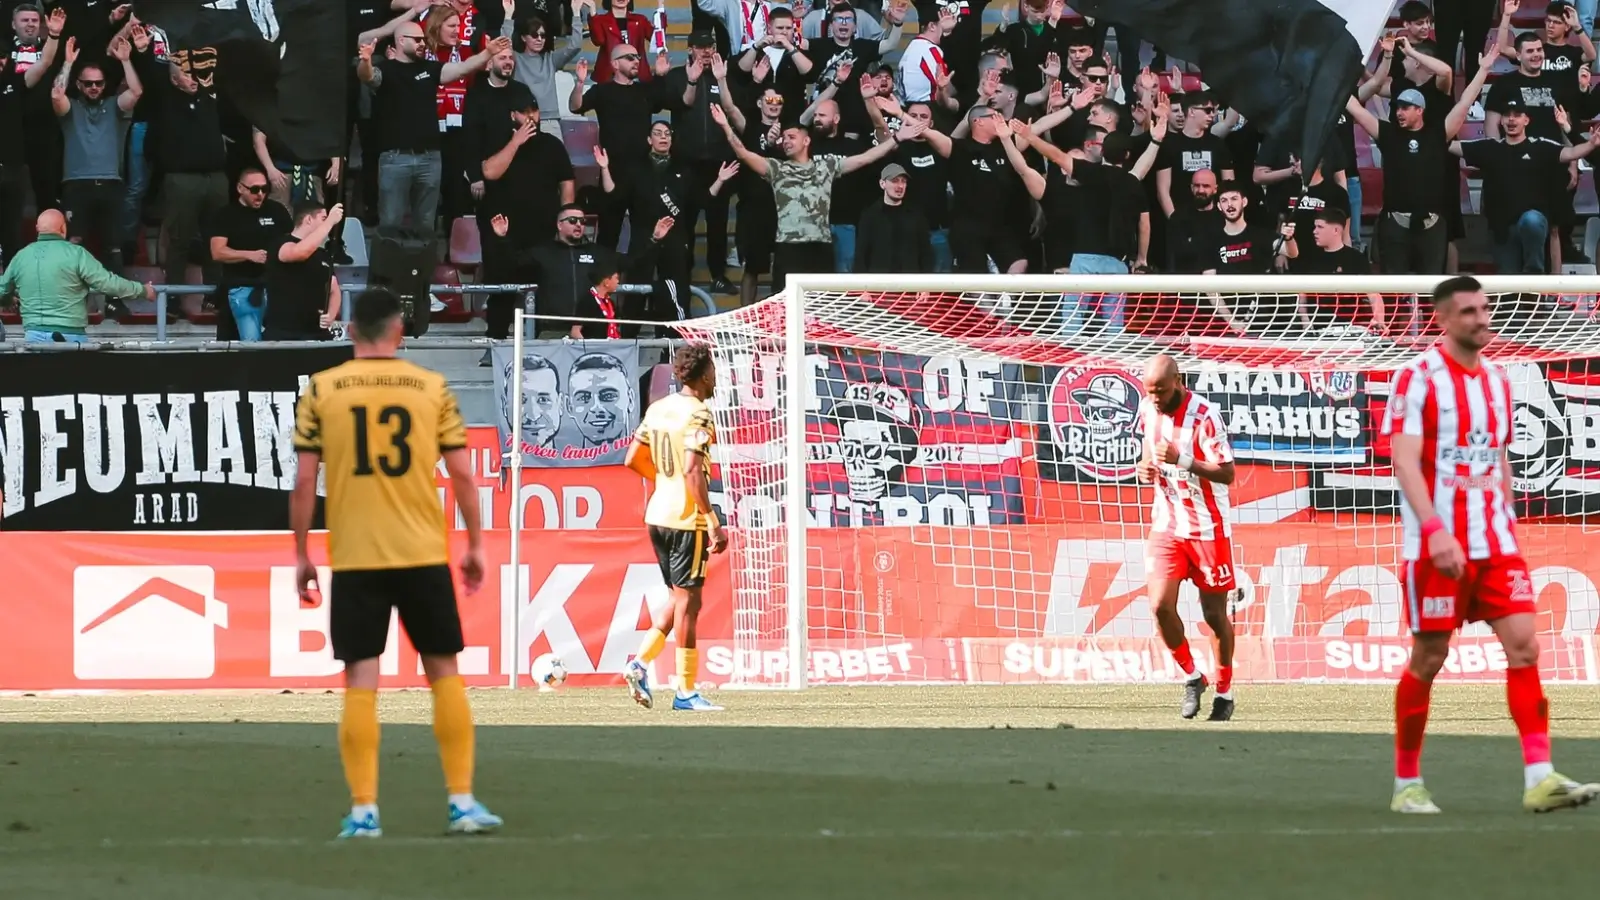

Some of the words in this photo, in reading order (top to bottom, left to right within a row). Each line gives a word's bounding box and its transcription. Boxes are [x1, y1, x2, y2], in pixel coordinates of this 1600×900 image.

[923, 355, 1000, 414] OF
[1195, 361, 1305, 396] ARAD
[1212, 403, 1361, 438] ARHUS
[349, 405, 411, 477] 13
[652, 430, 674, 477] 10
[924, 447, 965, 462] 2017
[1513, 481, 1536, 490] 2021
[133, 493, 199, 524] ARAD
[1217, 563, 1232, 579] 11
[1325, 641, 1509, 676] SUPRBE
